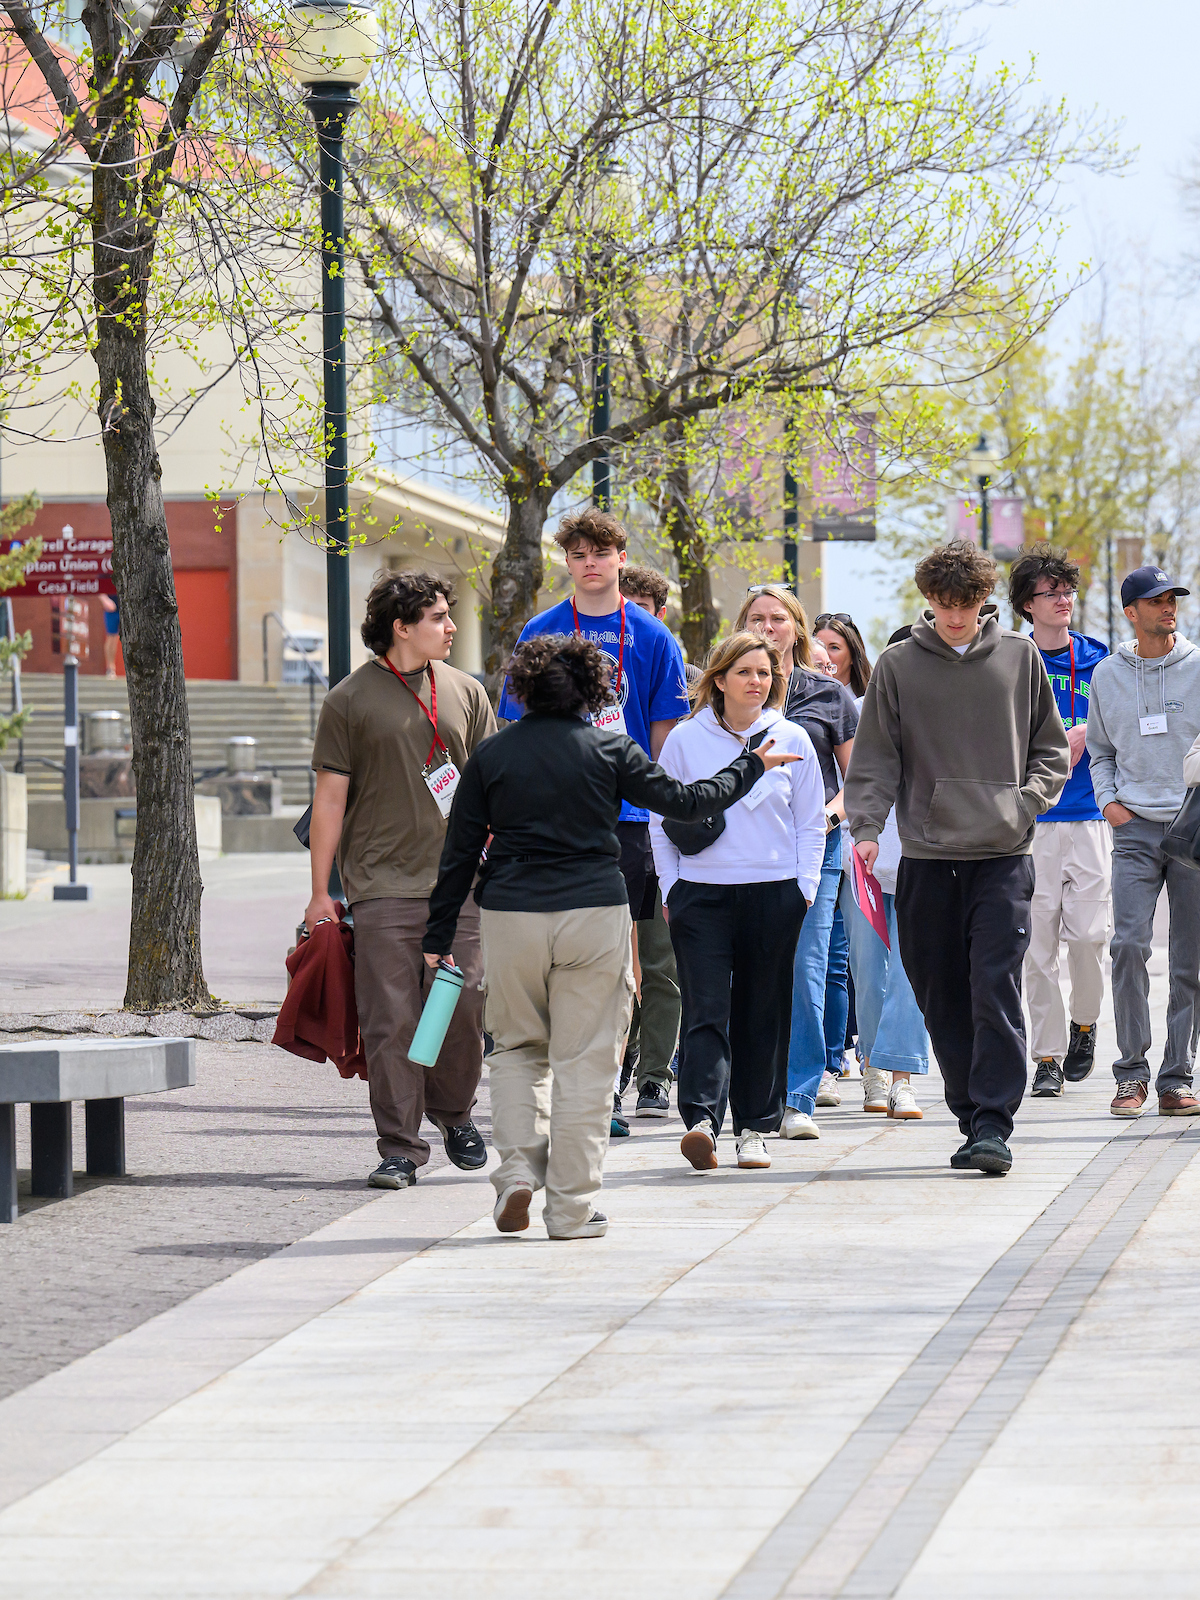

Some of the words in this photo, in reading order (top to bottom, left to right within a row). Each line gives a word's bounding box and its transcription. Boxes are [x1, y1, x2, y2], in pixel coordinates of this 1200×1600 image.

[67, 538, 113, 554] Garage
[22, 560, 57, 575] pton
[60, 558, 99, 572] Union
[38, 580, 68, 594] Gesa
[70, 579, 99, 594] Field
[1047, 674, 1091, 700] TTLE
[595, 711, 620, 728] WSU
[432, 768, 456, 794] WSU
